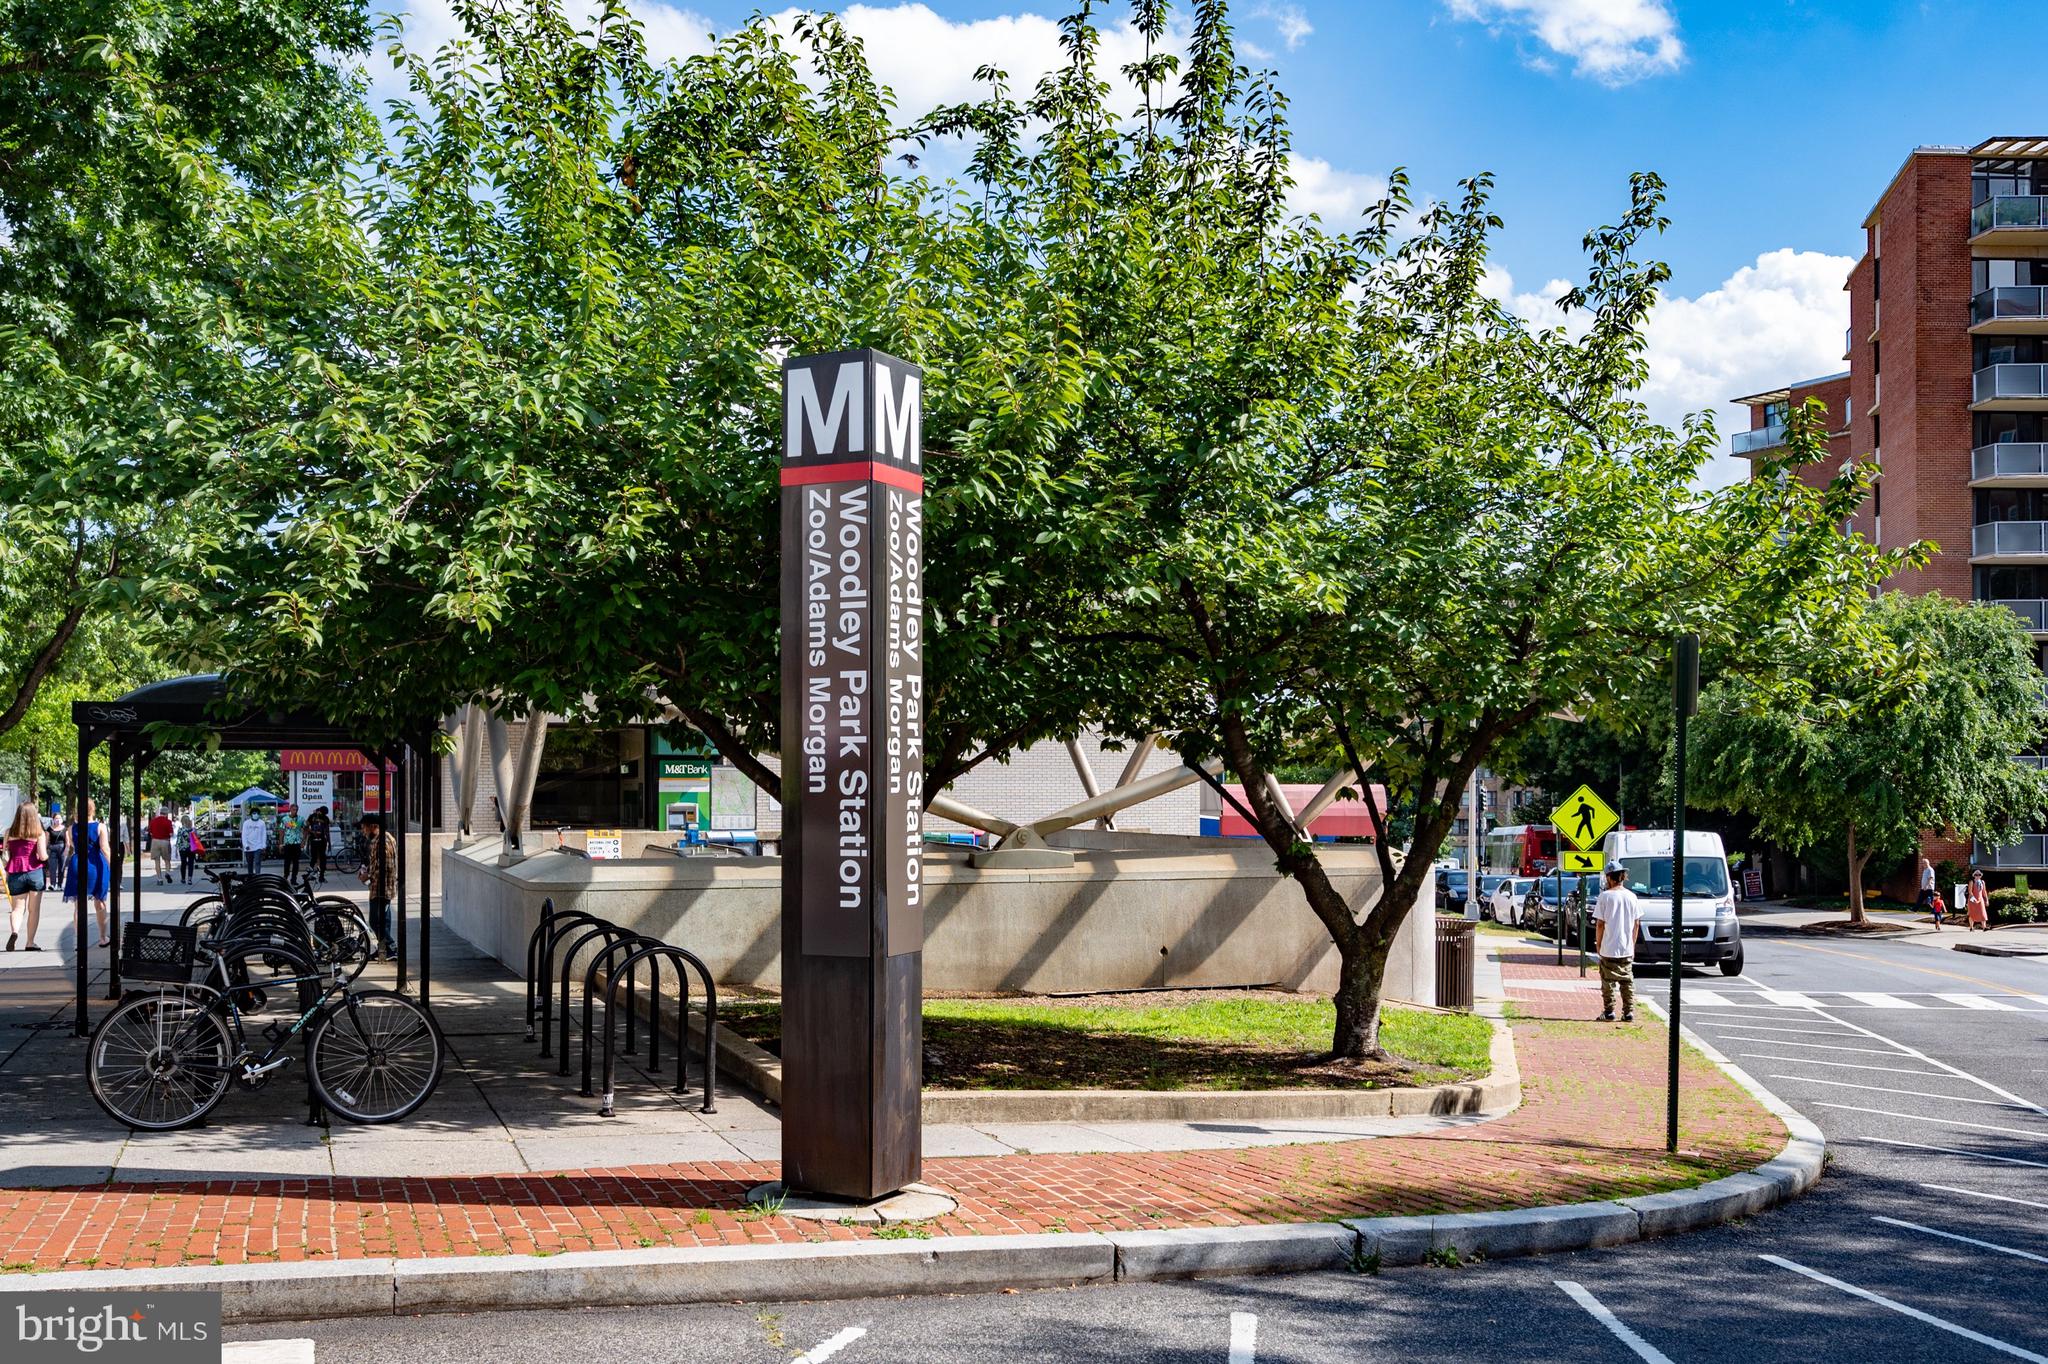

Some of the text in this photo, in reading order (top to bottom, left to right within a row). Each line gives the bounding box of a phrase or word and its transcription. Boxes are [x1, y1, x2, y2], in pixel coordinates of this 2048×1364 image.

[787, 361, 864, 458] M
[875, 362, 920, 465] M
[665, 764, 709, 774] M&T Bank
[803, 489, 831, 793] Zoo/Adams Morgan
[832, 486, 868, 908] Woodley Park Station
[888, 492, 903, 794] Zoo/Adams Morgan
[902, 500, 923, 906] Woodley Park Station
